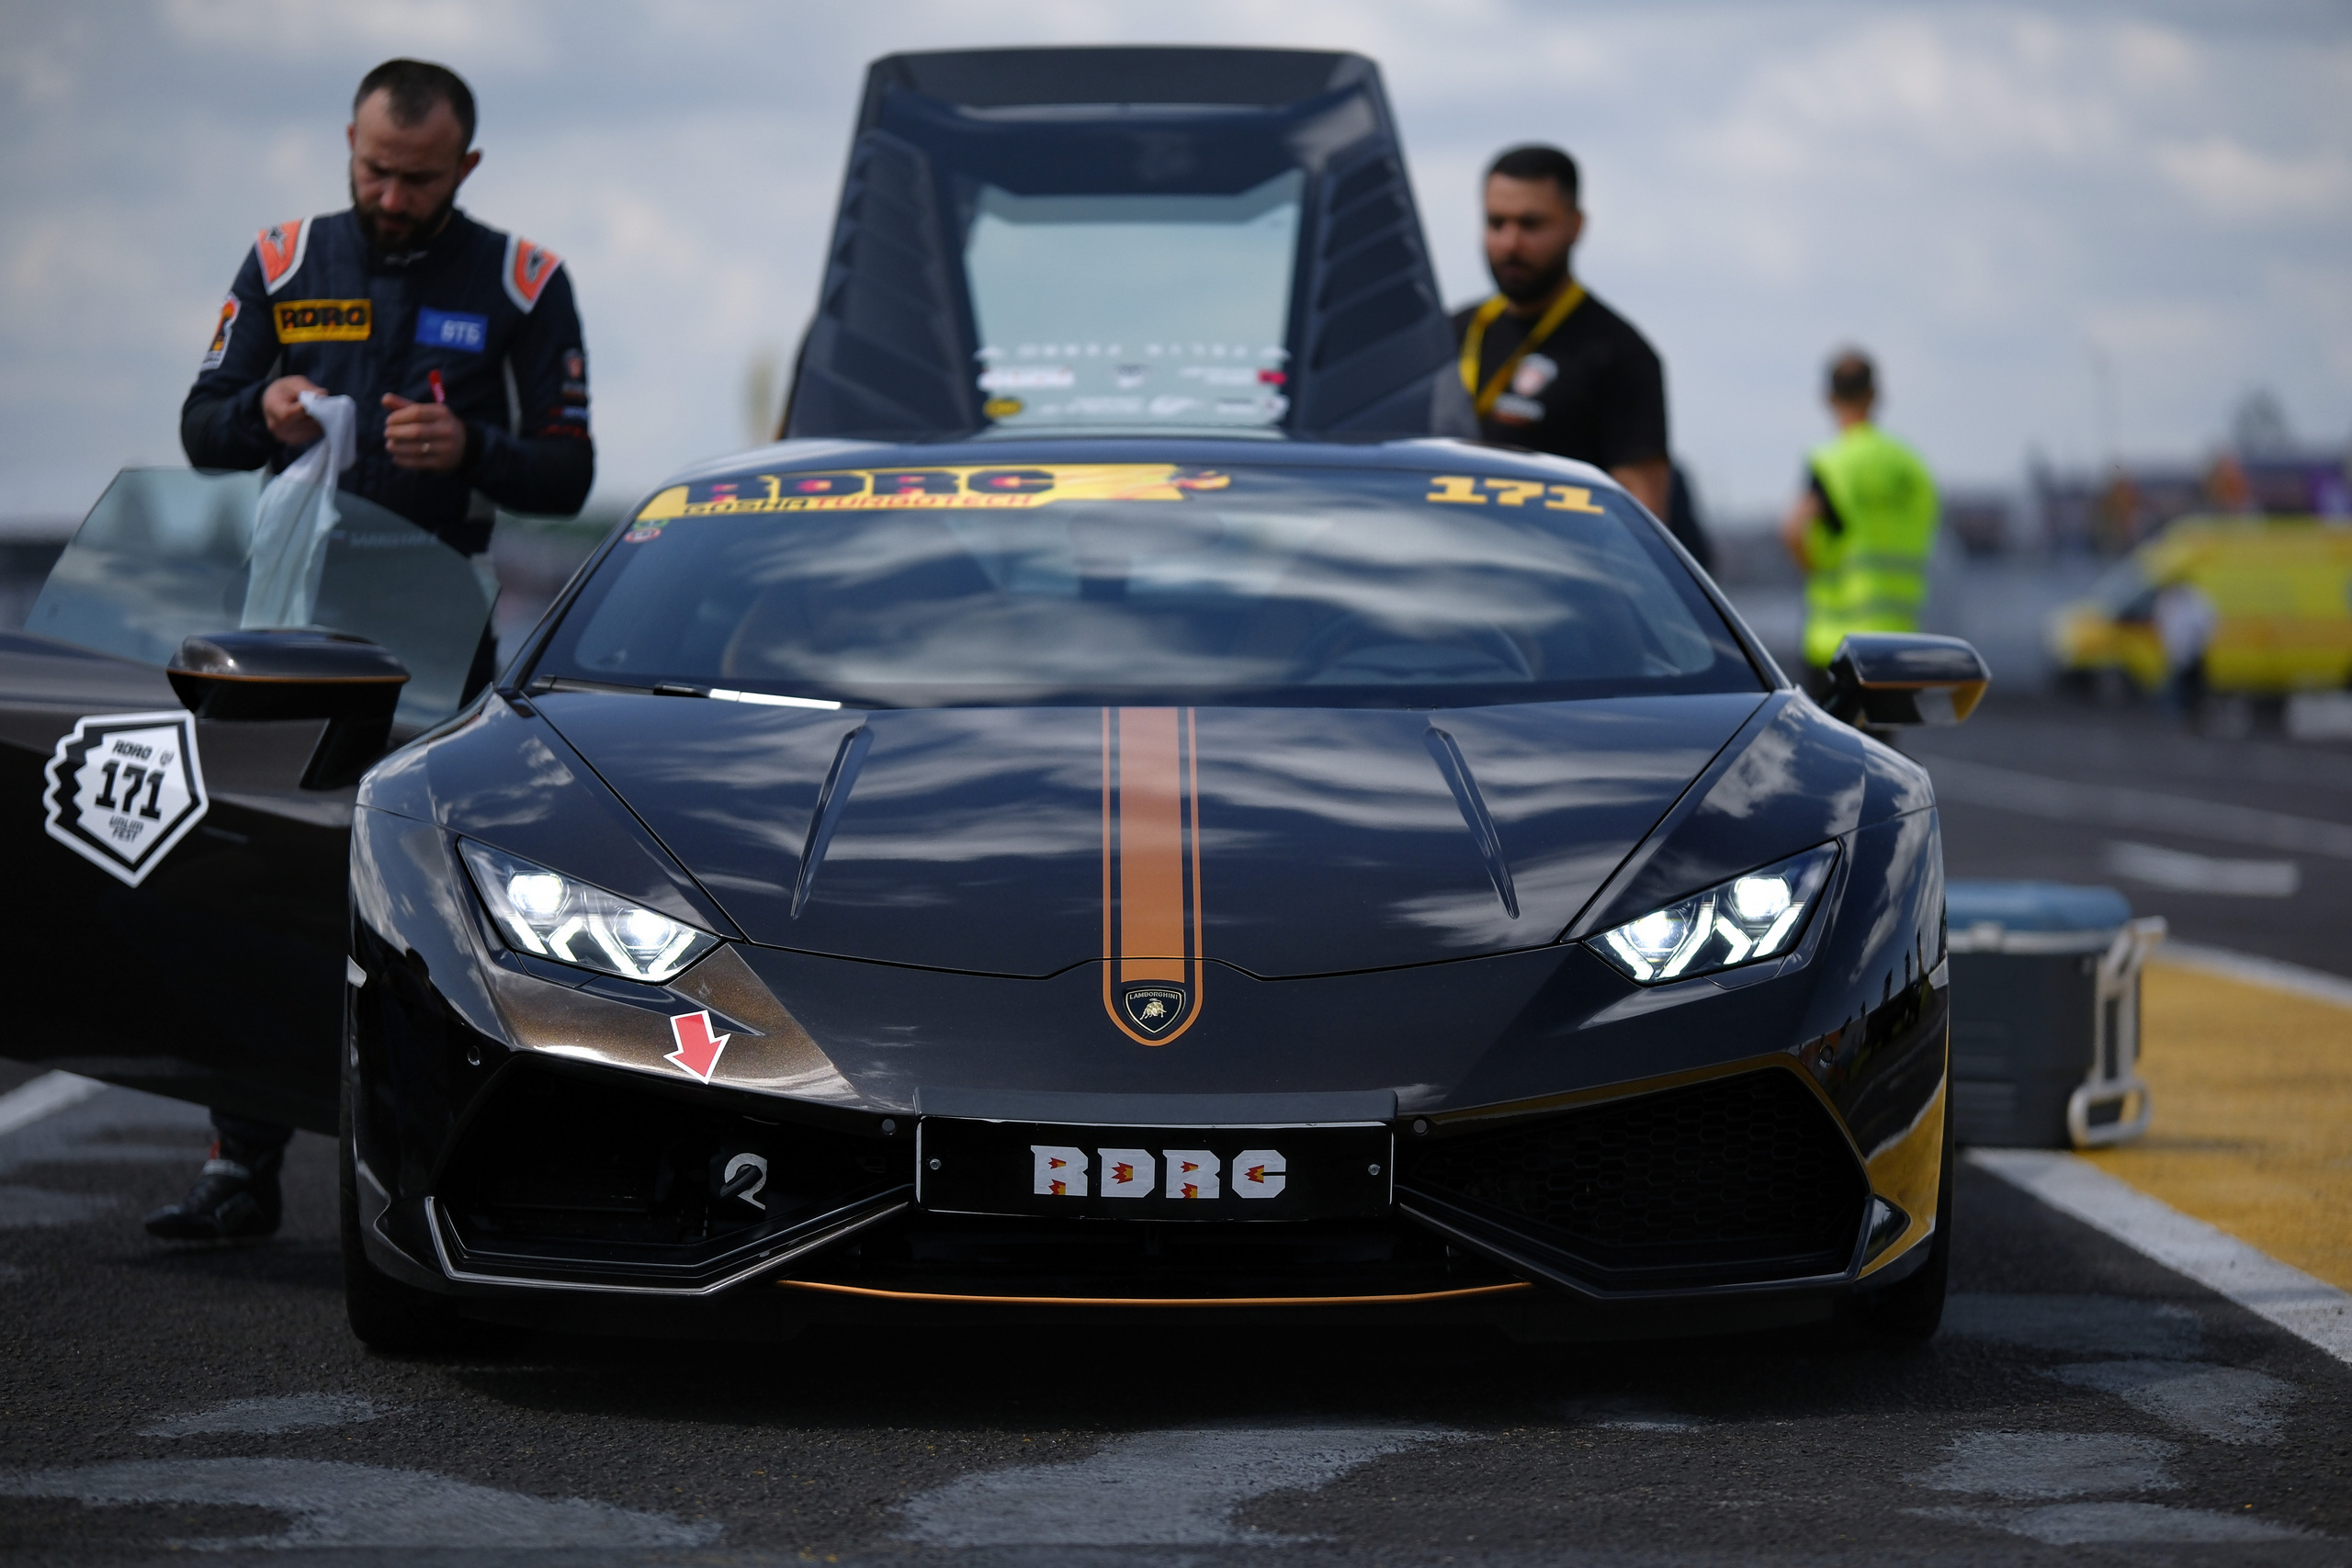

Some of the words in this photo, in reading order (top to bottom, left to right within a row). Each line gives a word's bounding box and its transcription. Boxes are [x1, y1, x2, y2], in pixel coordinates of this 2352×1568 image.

[1426, 476, 1605, 514] 171
[94, 758, 165, 822] 171
[1129, 991, 1179, 1000] LAMBORGHINI
[1030, 1145, 1287, 1199] RDRC
